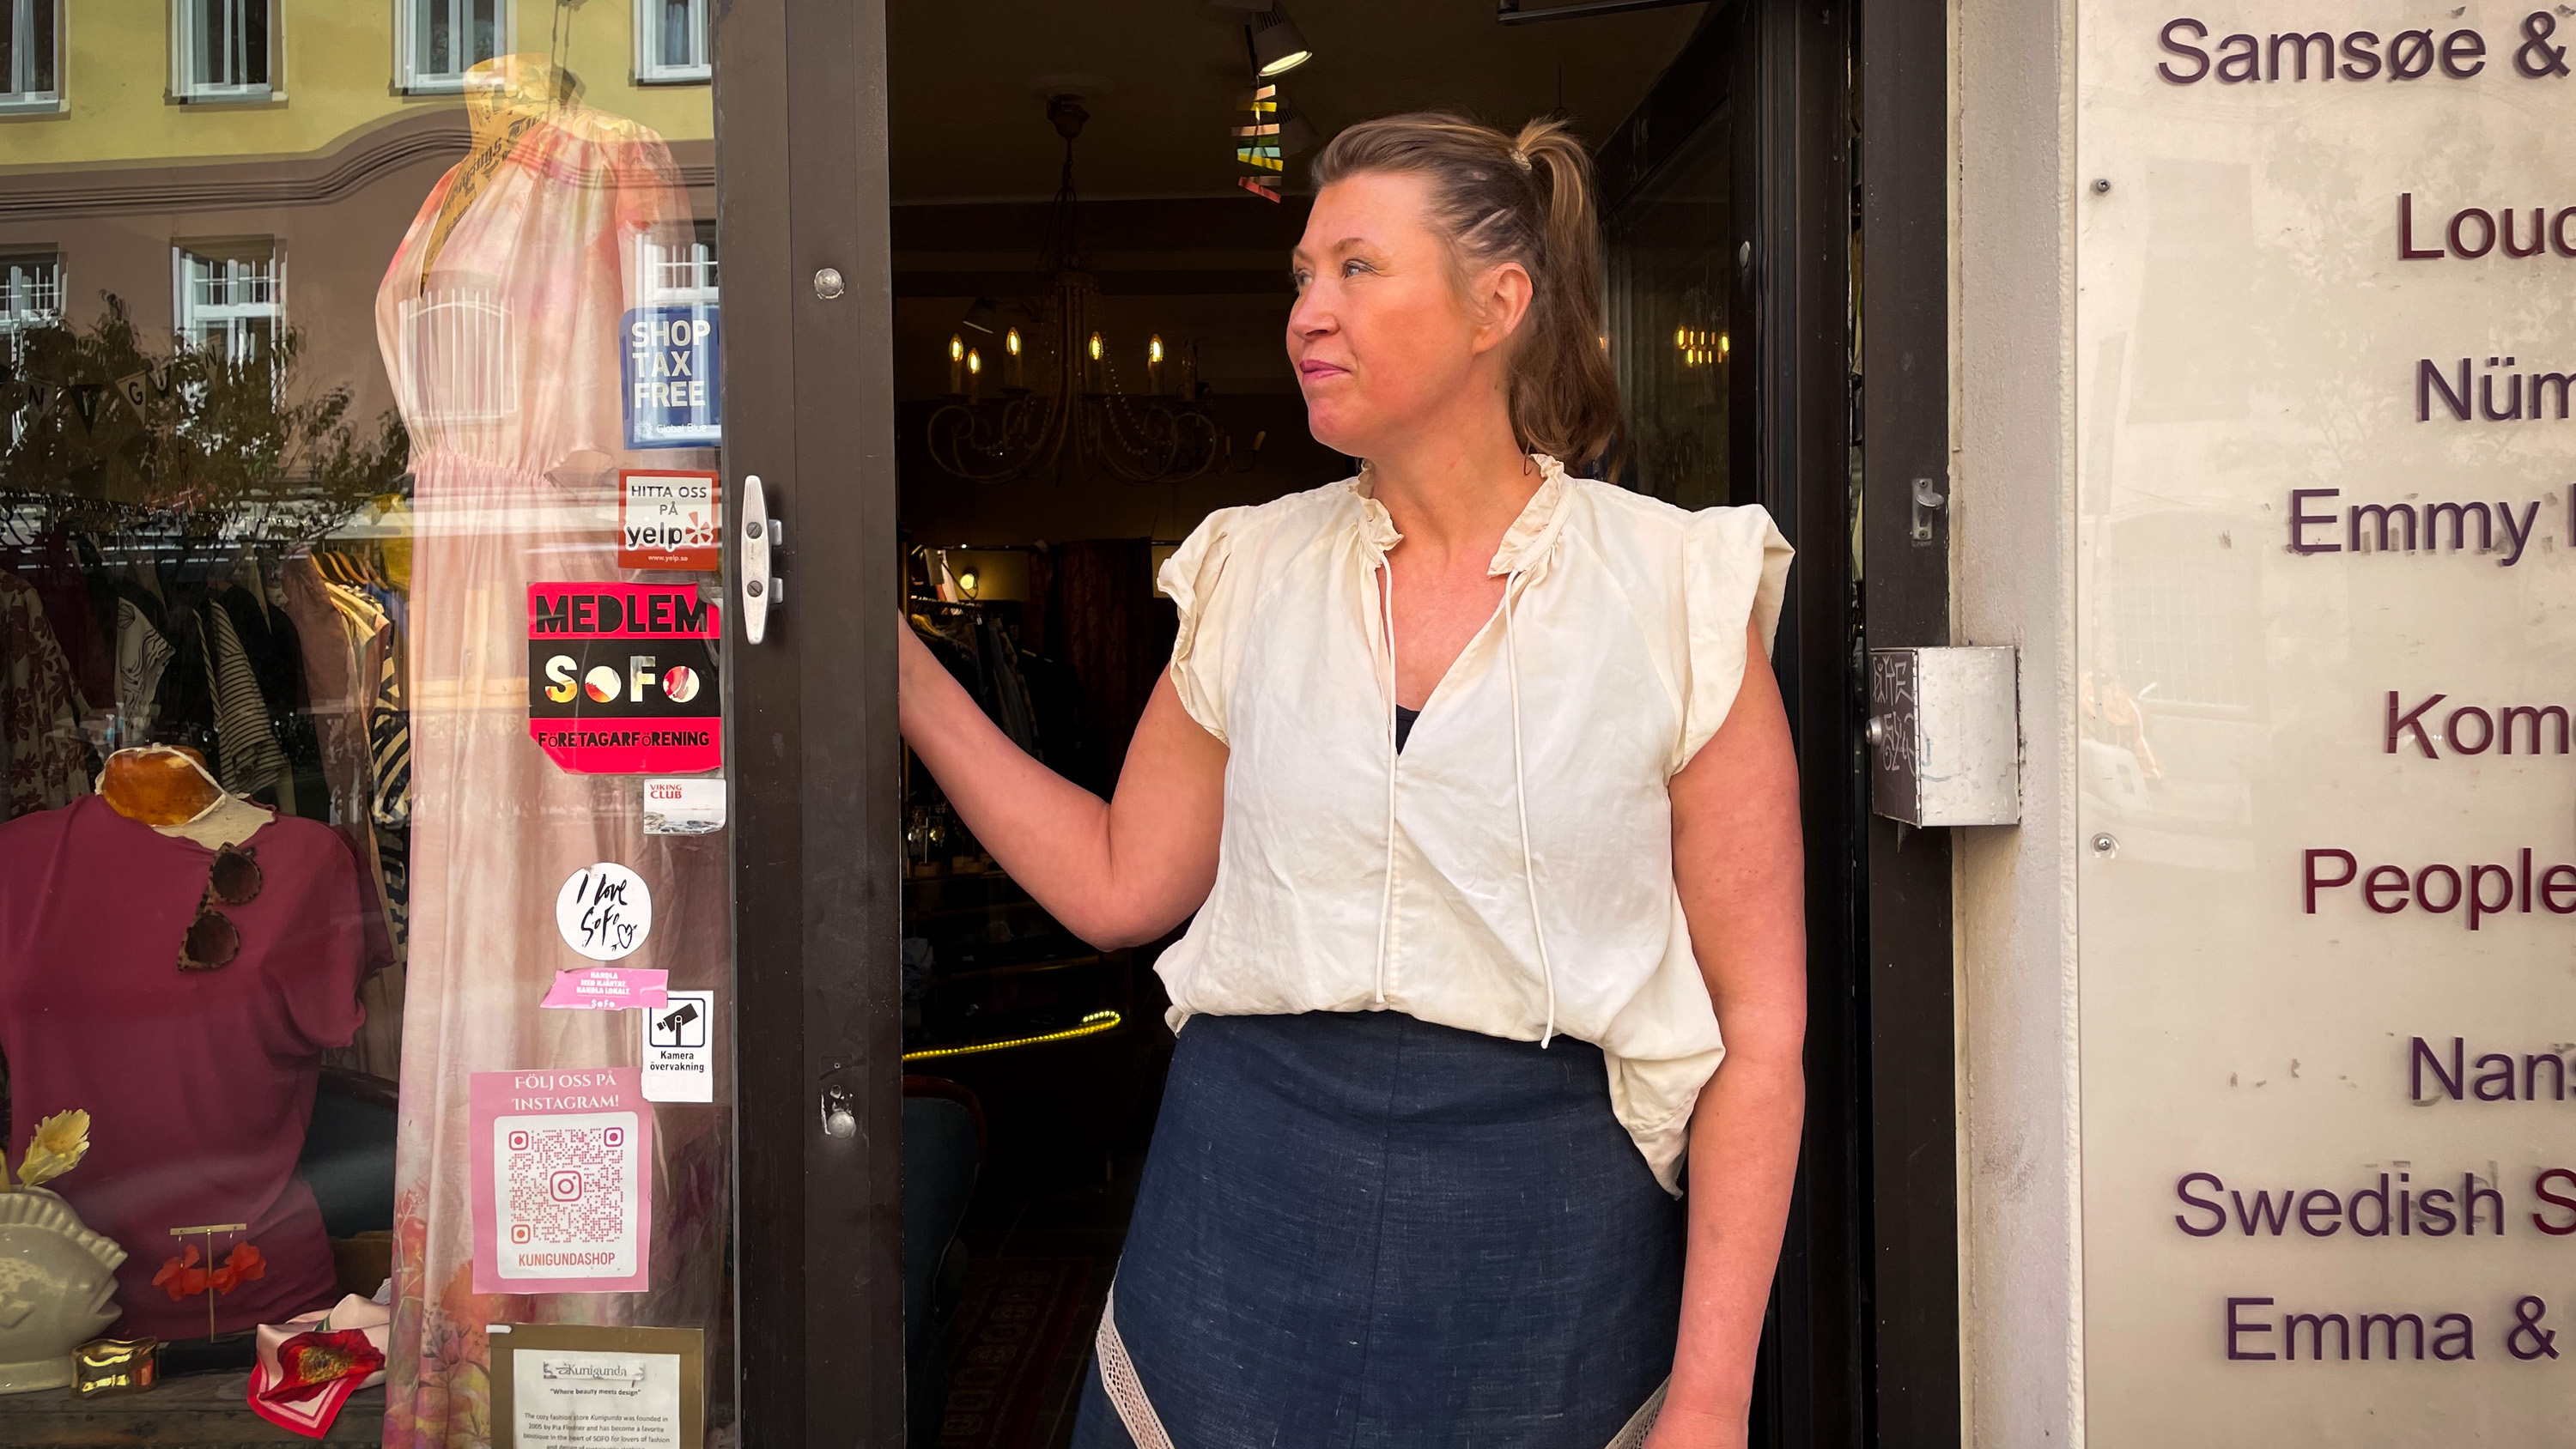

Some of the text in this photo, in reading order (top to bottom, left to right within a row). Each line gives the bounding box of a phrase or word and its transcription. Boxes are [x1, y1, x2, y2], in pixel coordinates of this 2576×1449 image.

[2158, 11, 2571, 83] Samsøe &
[632, 320, 710, 347] SHOP
[632, 351, 691, 378] TAX
[635, 381, 707, 408] FREE
[656, 422, 707, 433] Global Blue
[631, 485, 707, 498] HITTA OSS
[659, 500, 678, 515] PÅ
[627, 521, 683, 549] yelp
[2292, 488, 2541, 567] Emmy
[647, 555, 689, 563] www.yelp.se
[536, 594, 708, 633] MEDLEM
[650, 791, 683, 799] CLUB
[576, 874, 589, 905] I
[2305, 846, 2576, 931] People
[650, 1062, 705, 1073] övervakning
[660, 1051, 694, 1060] Kamera
[2412, 1036, 2576, 1101] Nan
[515, 1070, 617, 1091] FÖLJ OSS PÅ
[511, 1094, 619, 1111] INSTAGRAM!
[2176, 1173, 2504, 1237] Swedish
[518, 1252, 616, 1266] KUNIGUNDASHOP
[2227, 1295, 2560, 1361] Emma &
